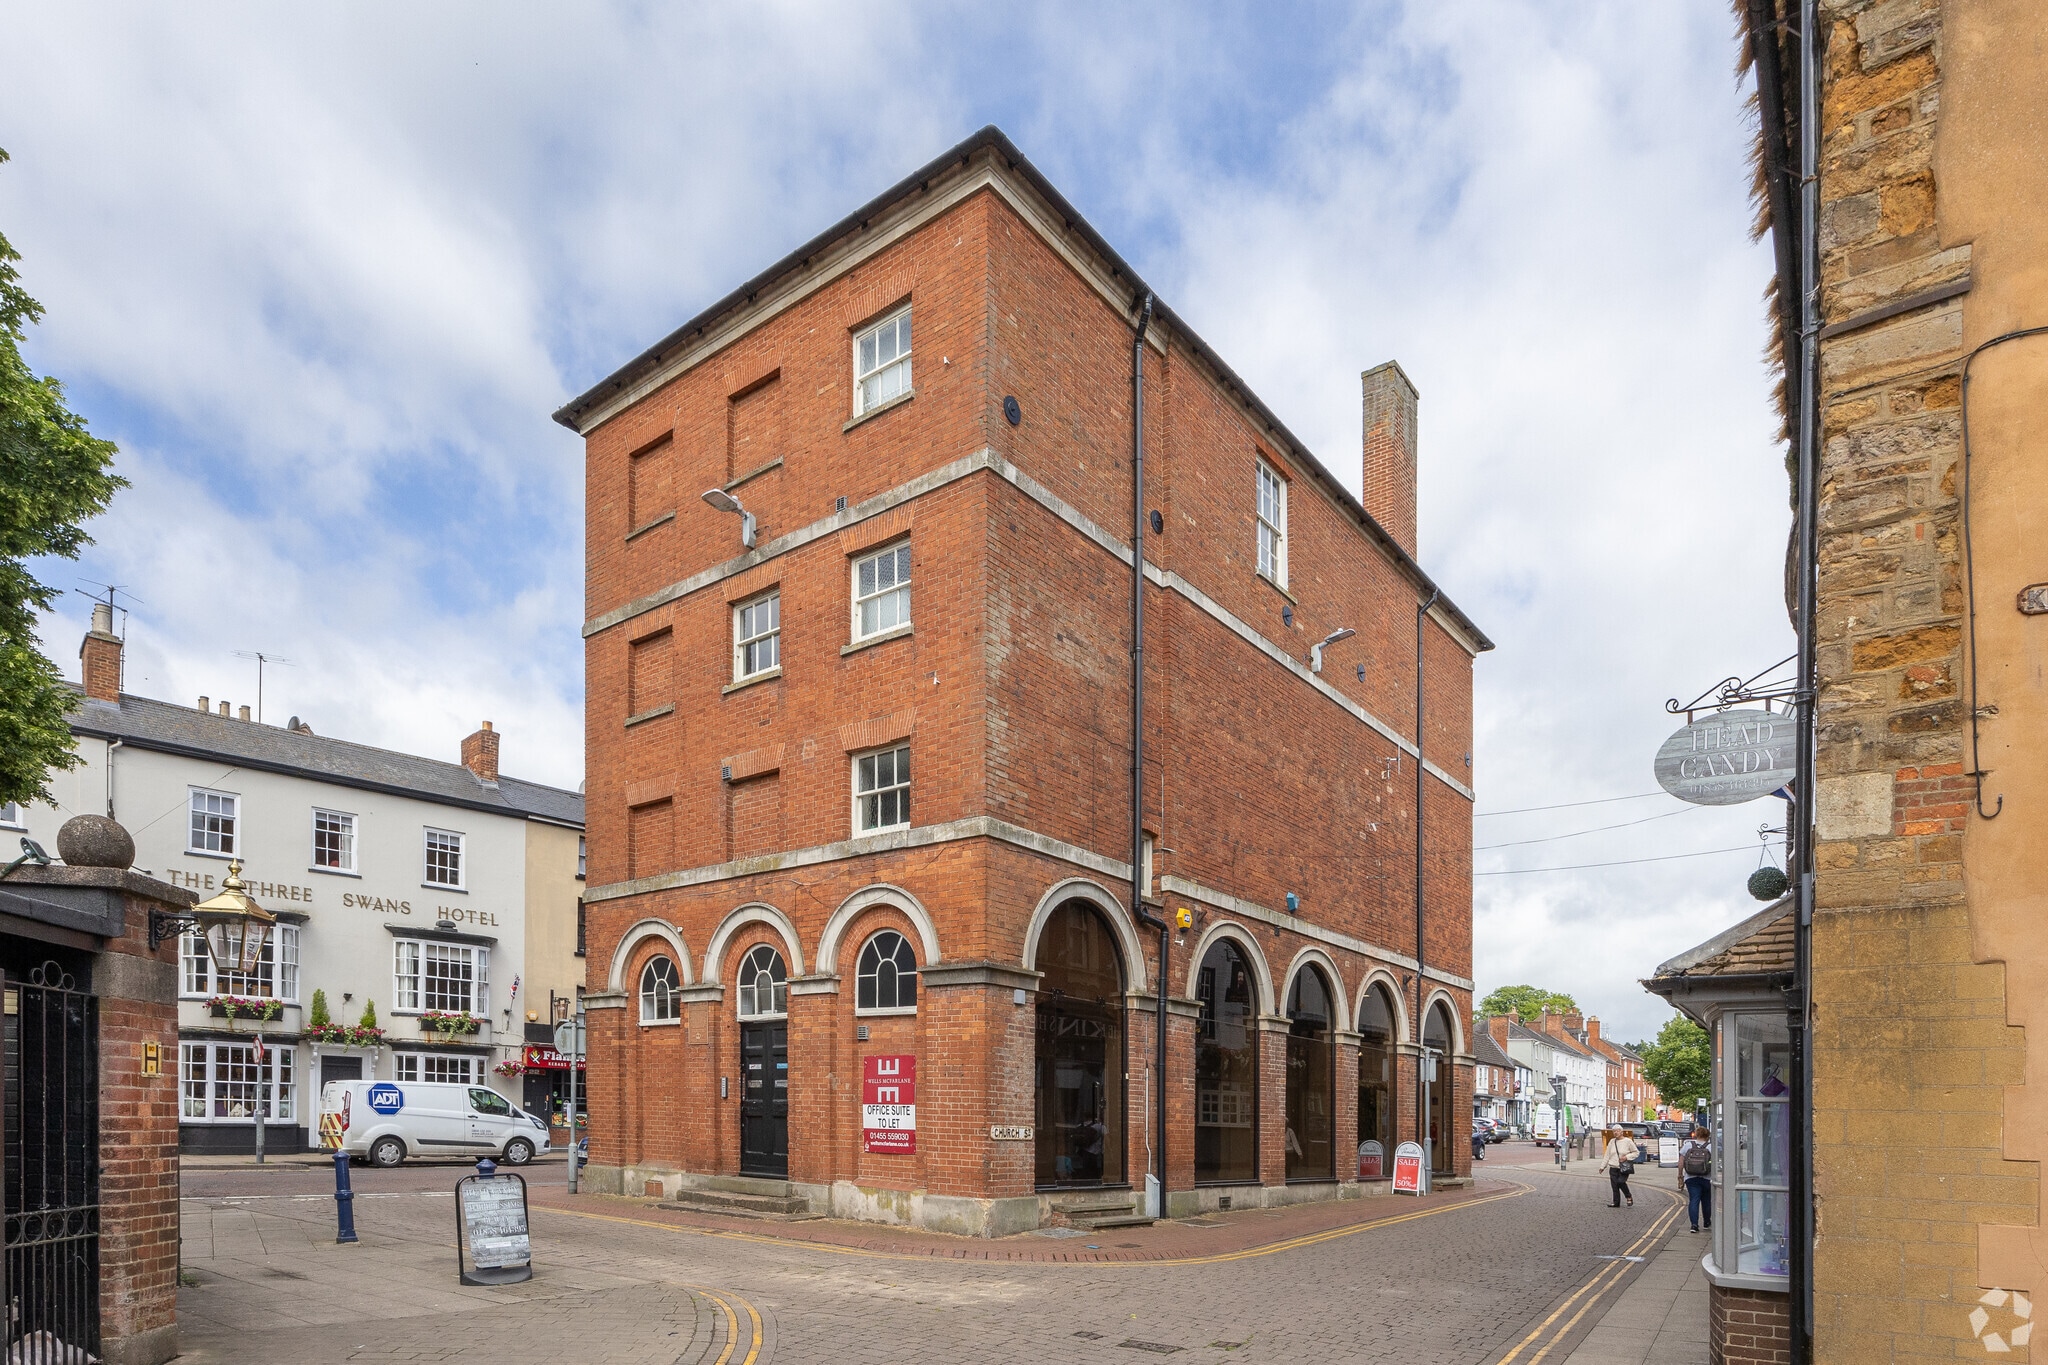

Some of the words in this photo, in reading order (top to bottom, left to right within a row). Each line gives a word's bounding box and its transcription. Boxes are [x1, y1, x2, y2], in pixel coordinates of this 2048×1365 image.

[1689, 722, 1774, 752] HEAD
[1680, 747, 1781, 779] CANDY
[167, 869, 215, 890] THE
[246, 880, 313, 902] THREE
[343, 893, 411, 915] SWANS
[438, 905, 499, 927] HOTEL
[543, 1050, 586, 1062] Flas
[374, 1092, 398, 1105] ADT
[867, 1105, 889, 1115] OFFICE
[892, 1105, 910, 1116] SUITE
[878, 1118, 887, 1128] TO
[888, 1118, 900, 1128] LET
[869, 1132, 886, 1140] 01455
[888, 1133, 909, 1141] 559030
[994, 1128, 1019, 1138] CHURCH
[1398, 1158, 1418, 1166] SALE
